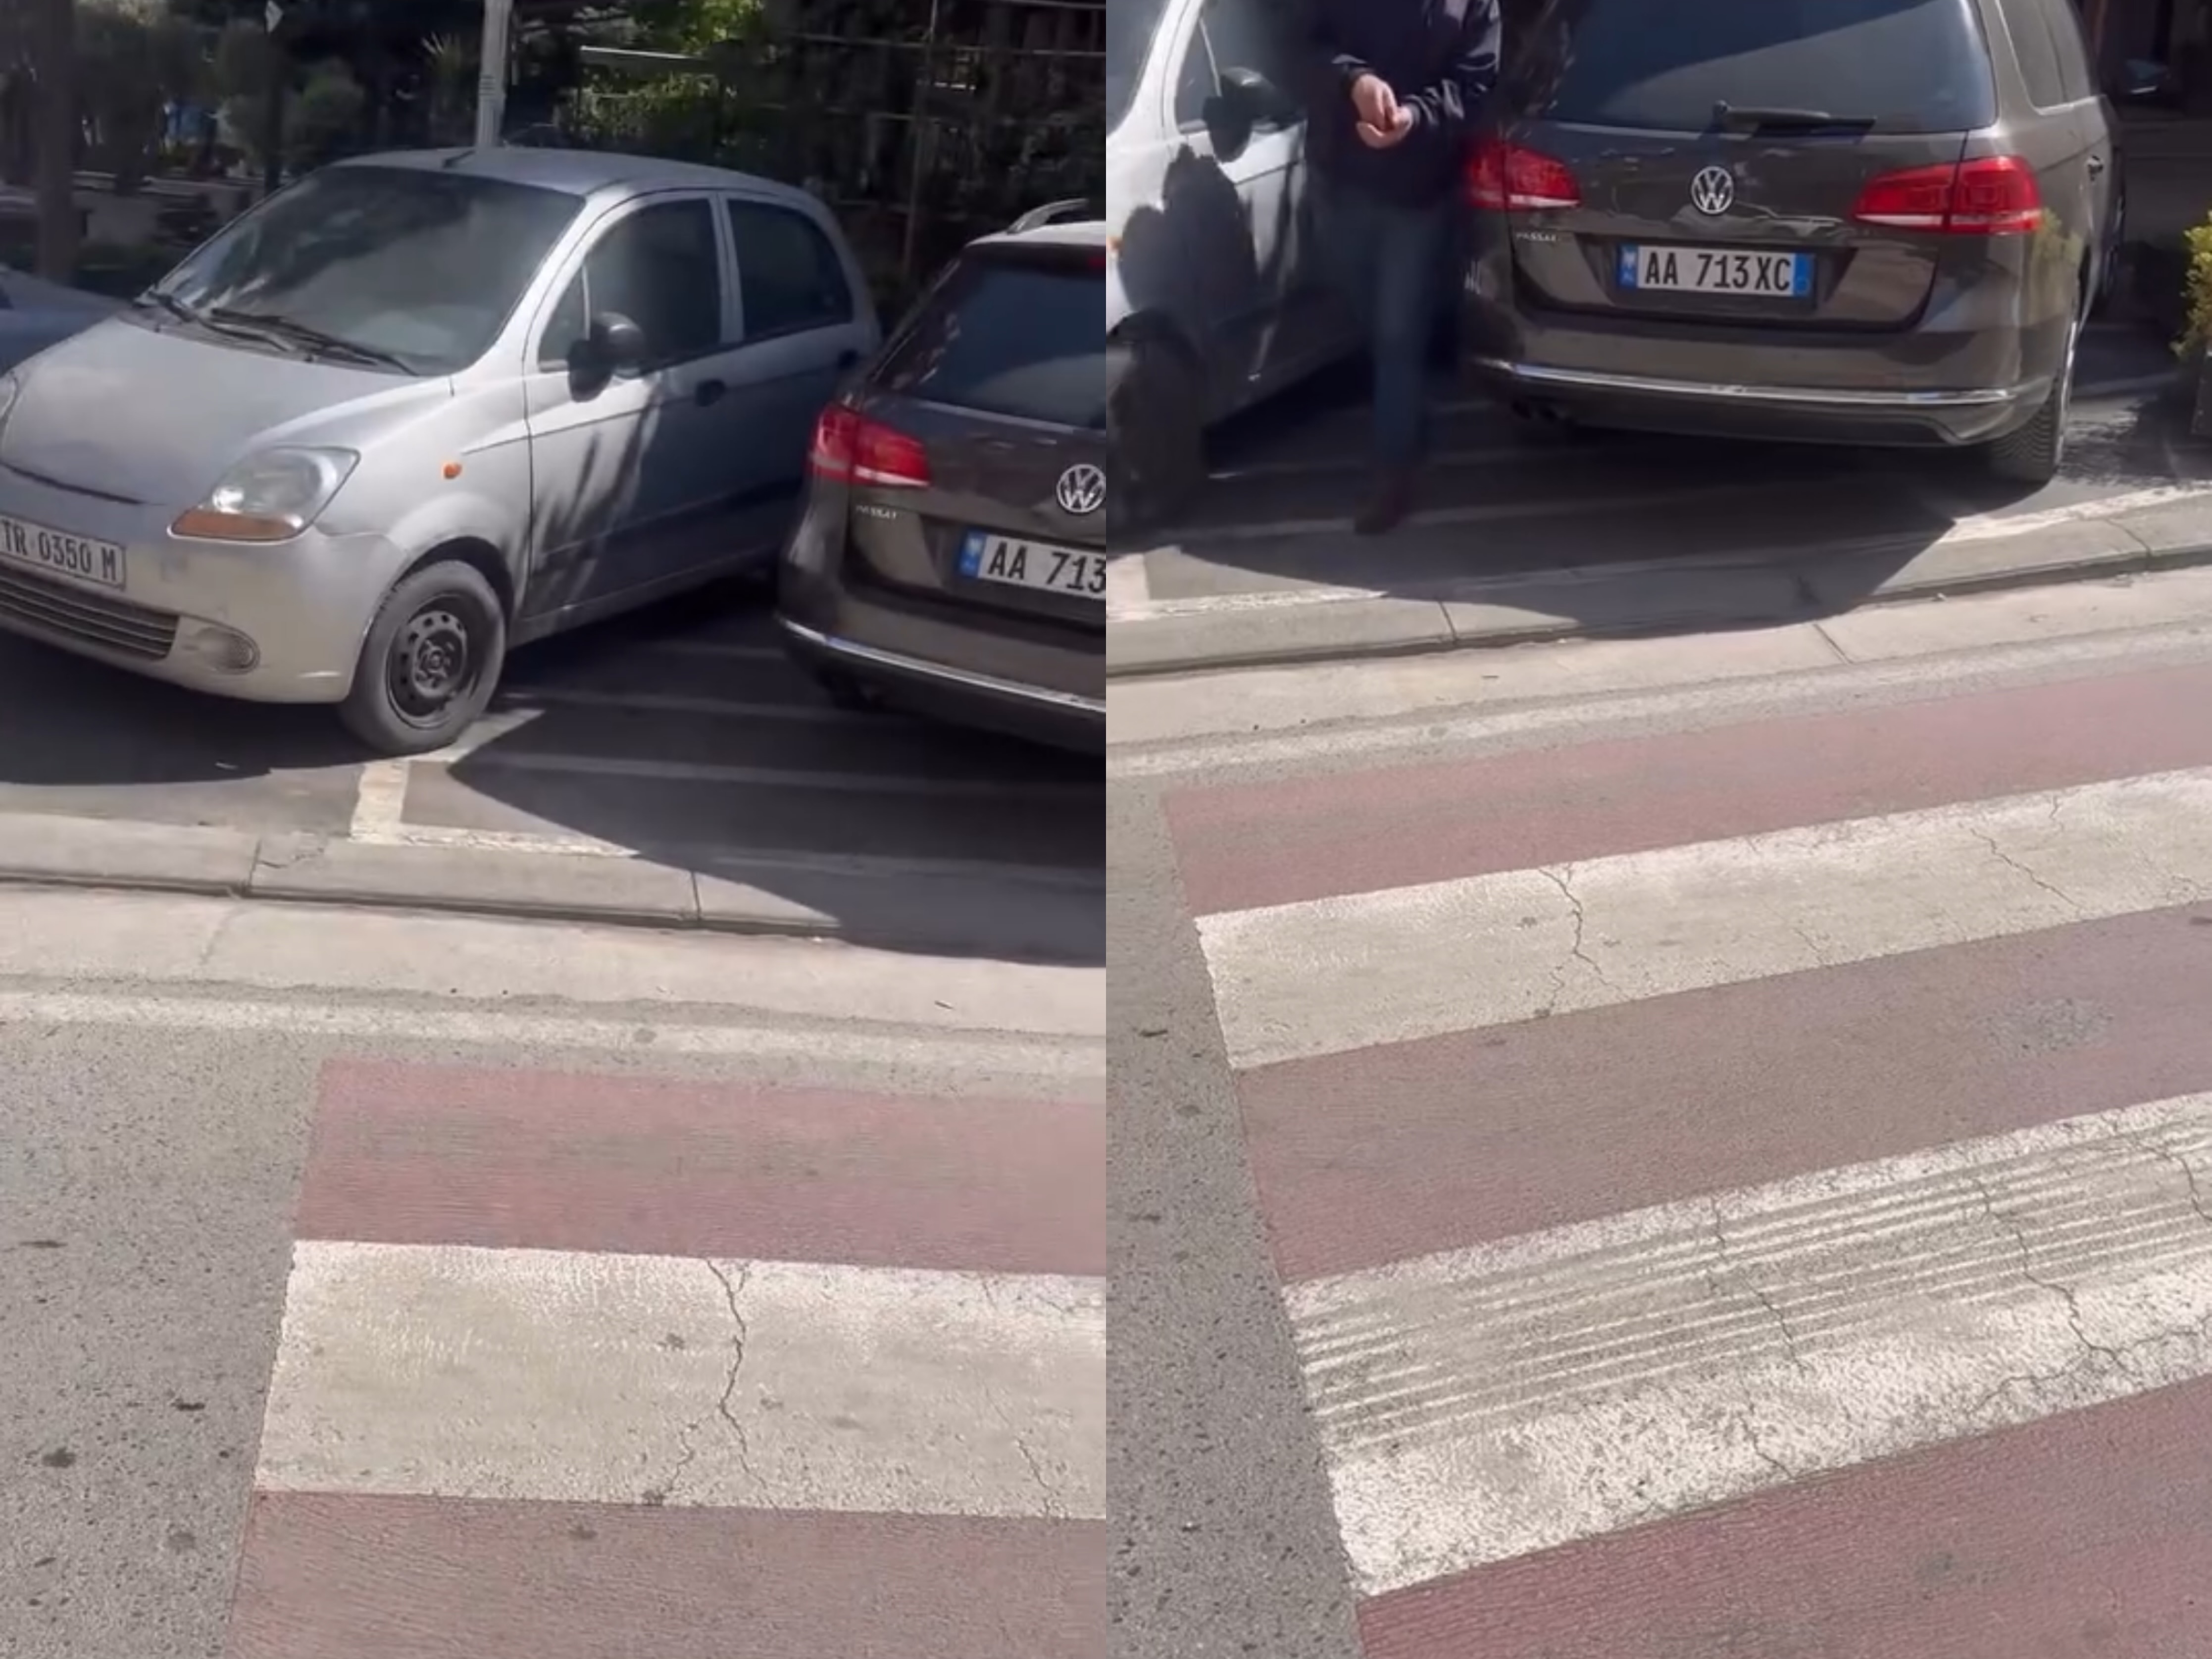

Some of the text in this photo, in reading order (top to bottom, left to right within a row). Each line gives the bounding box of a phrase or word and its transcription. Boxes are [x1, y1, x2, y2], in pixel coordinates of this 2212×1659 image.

[1645, 252, 1678, 285] AA
[3, 520, 117, 581] TR 0350 M
[988, 541, 1106, 593] AA 713
